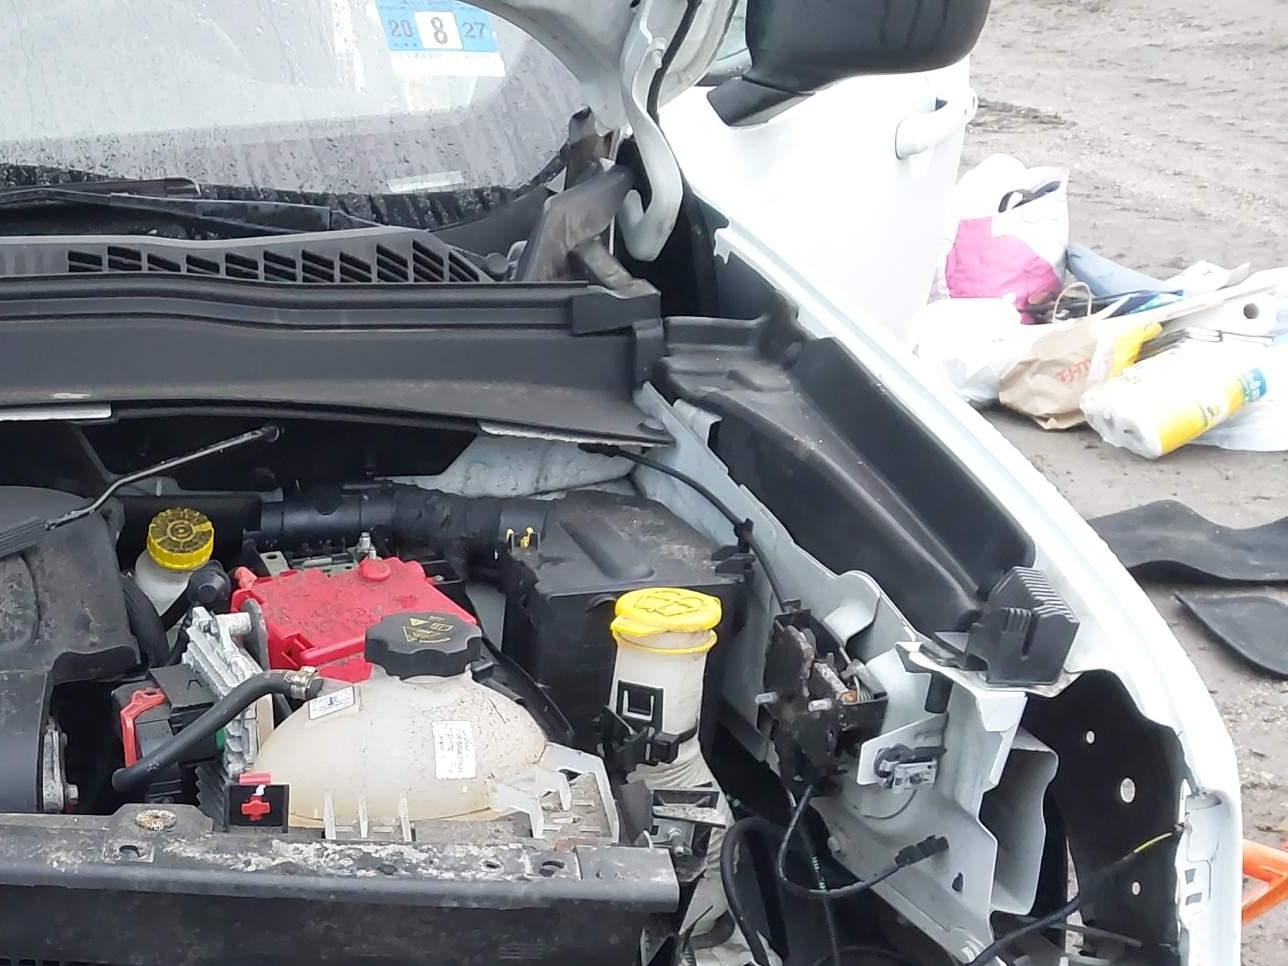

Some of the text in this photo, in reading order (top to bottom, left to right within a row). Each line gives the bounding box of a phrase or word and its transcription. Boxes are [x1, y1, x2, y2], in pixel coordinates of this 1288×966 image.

[388, 16, 486, 45] 20 8 27
